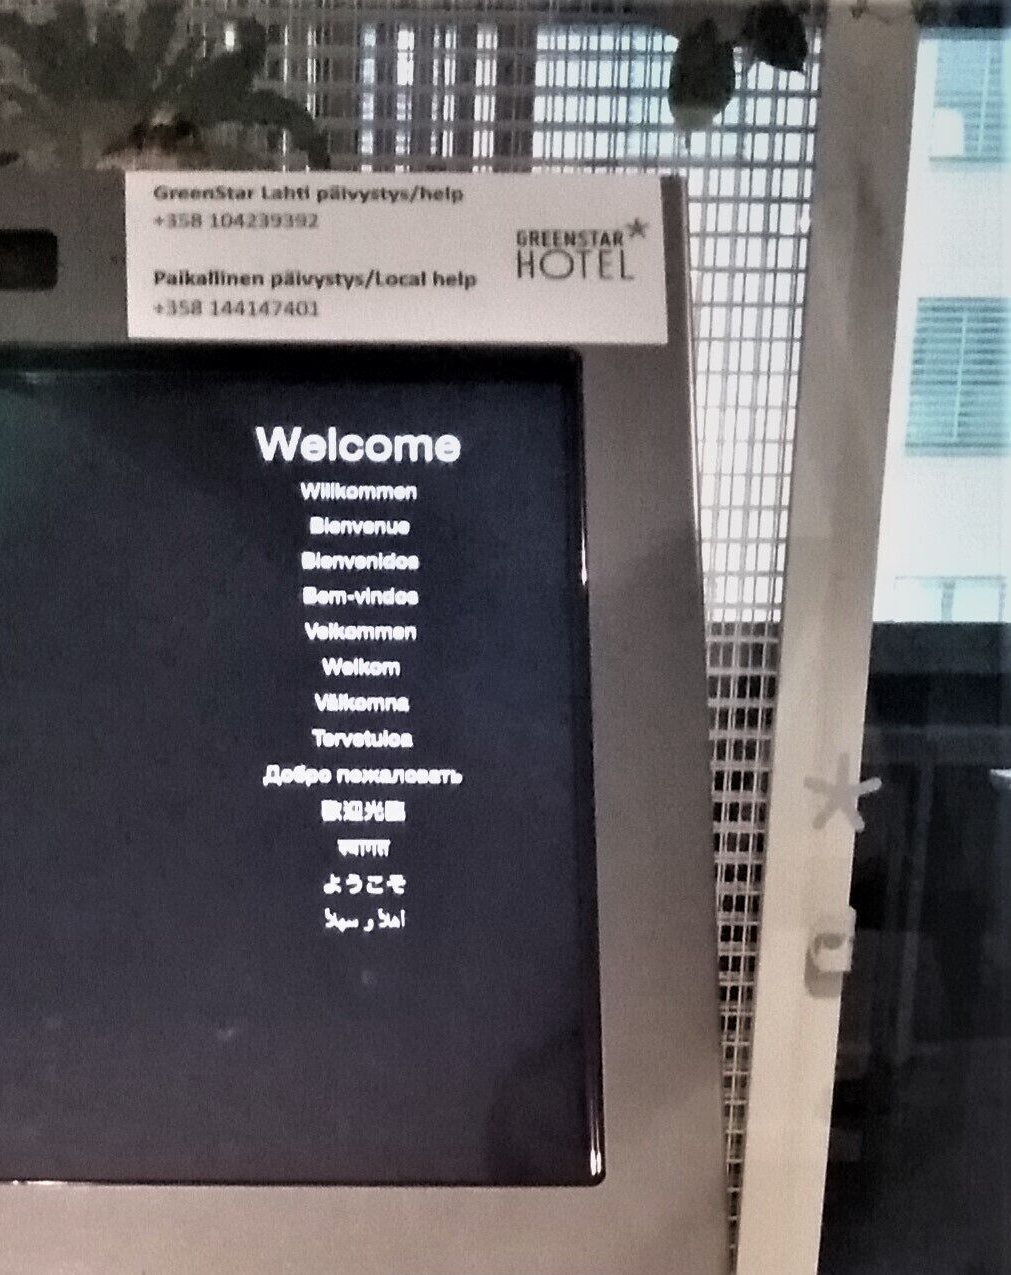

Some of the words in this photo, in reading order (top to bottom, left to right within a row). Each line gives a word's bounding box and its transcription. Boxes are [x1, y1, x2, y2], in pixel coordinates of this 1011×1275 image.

[153, 184, 253, 200] GreenStar
[261, 185, 310, 200] Lahti
[317, 184, 464, 203] päivystys/help
[153, 213, 203, 228] +358
[211, 213, 318, 228] 104239392
[516, 229, 624, 247] GREENSTAR
[517, 248, 635, 280] HOTEL
[154, 269, 265, 286] Paikallinen
[271, 269, 427, 290] päivystys/Local
[433, 270, 478, 290] help
[153, 300, 203, 316] +358
[211, 300, 318, 317] 144147401
[255, 426, 462, 463] Welcome
[300, 481, 418, 501] Willkommen
[309, 516, 411, 535] Bienvenue
[300, 551, 420, 570] Bienvenidos
[302, 585, 419, 605] Bem-vindos
[304, 621, 417, 641] Velkommen
[321, 656, 401, 676] Welkom
[314, 692, 410, 713] Välkomna
[311, 728, 414, 748] Tervetuloa
[262, 764, 333, 787] Добро
[336, 768, 463, 785] пожаловать
[323, 873, 407, 895] ようこそ
